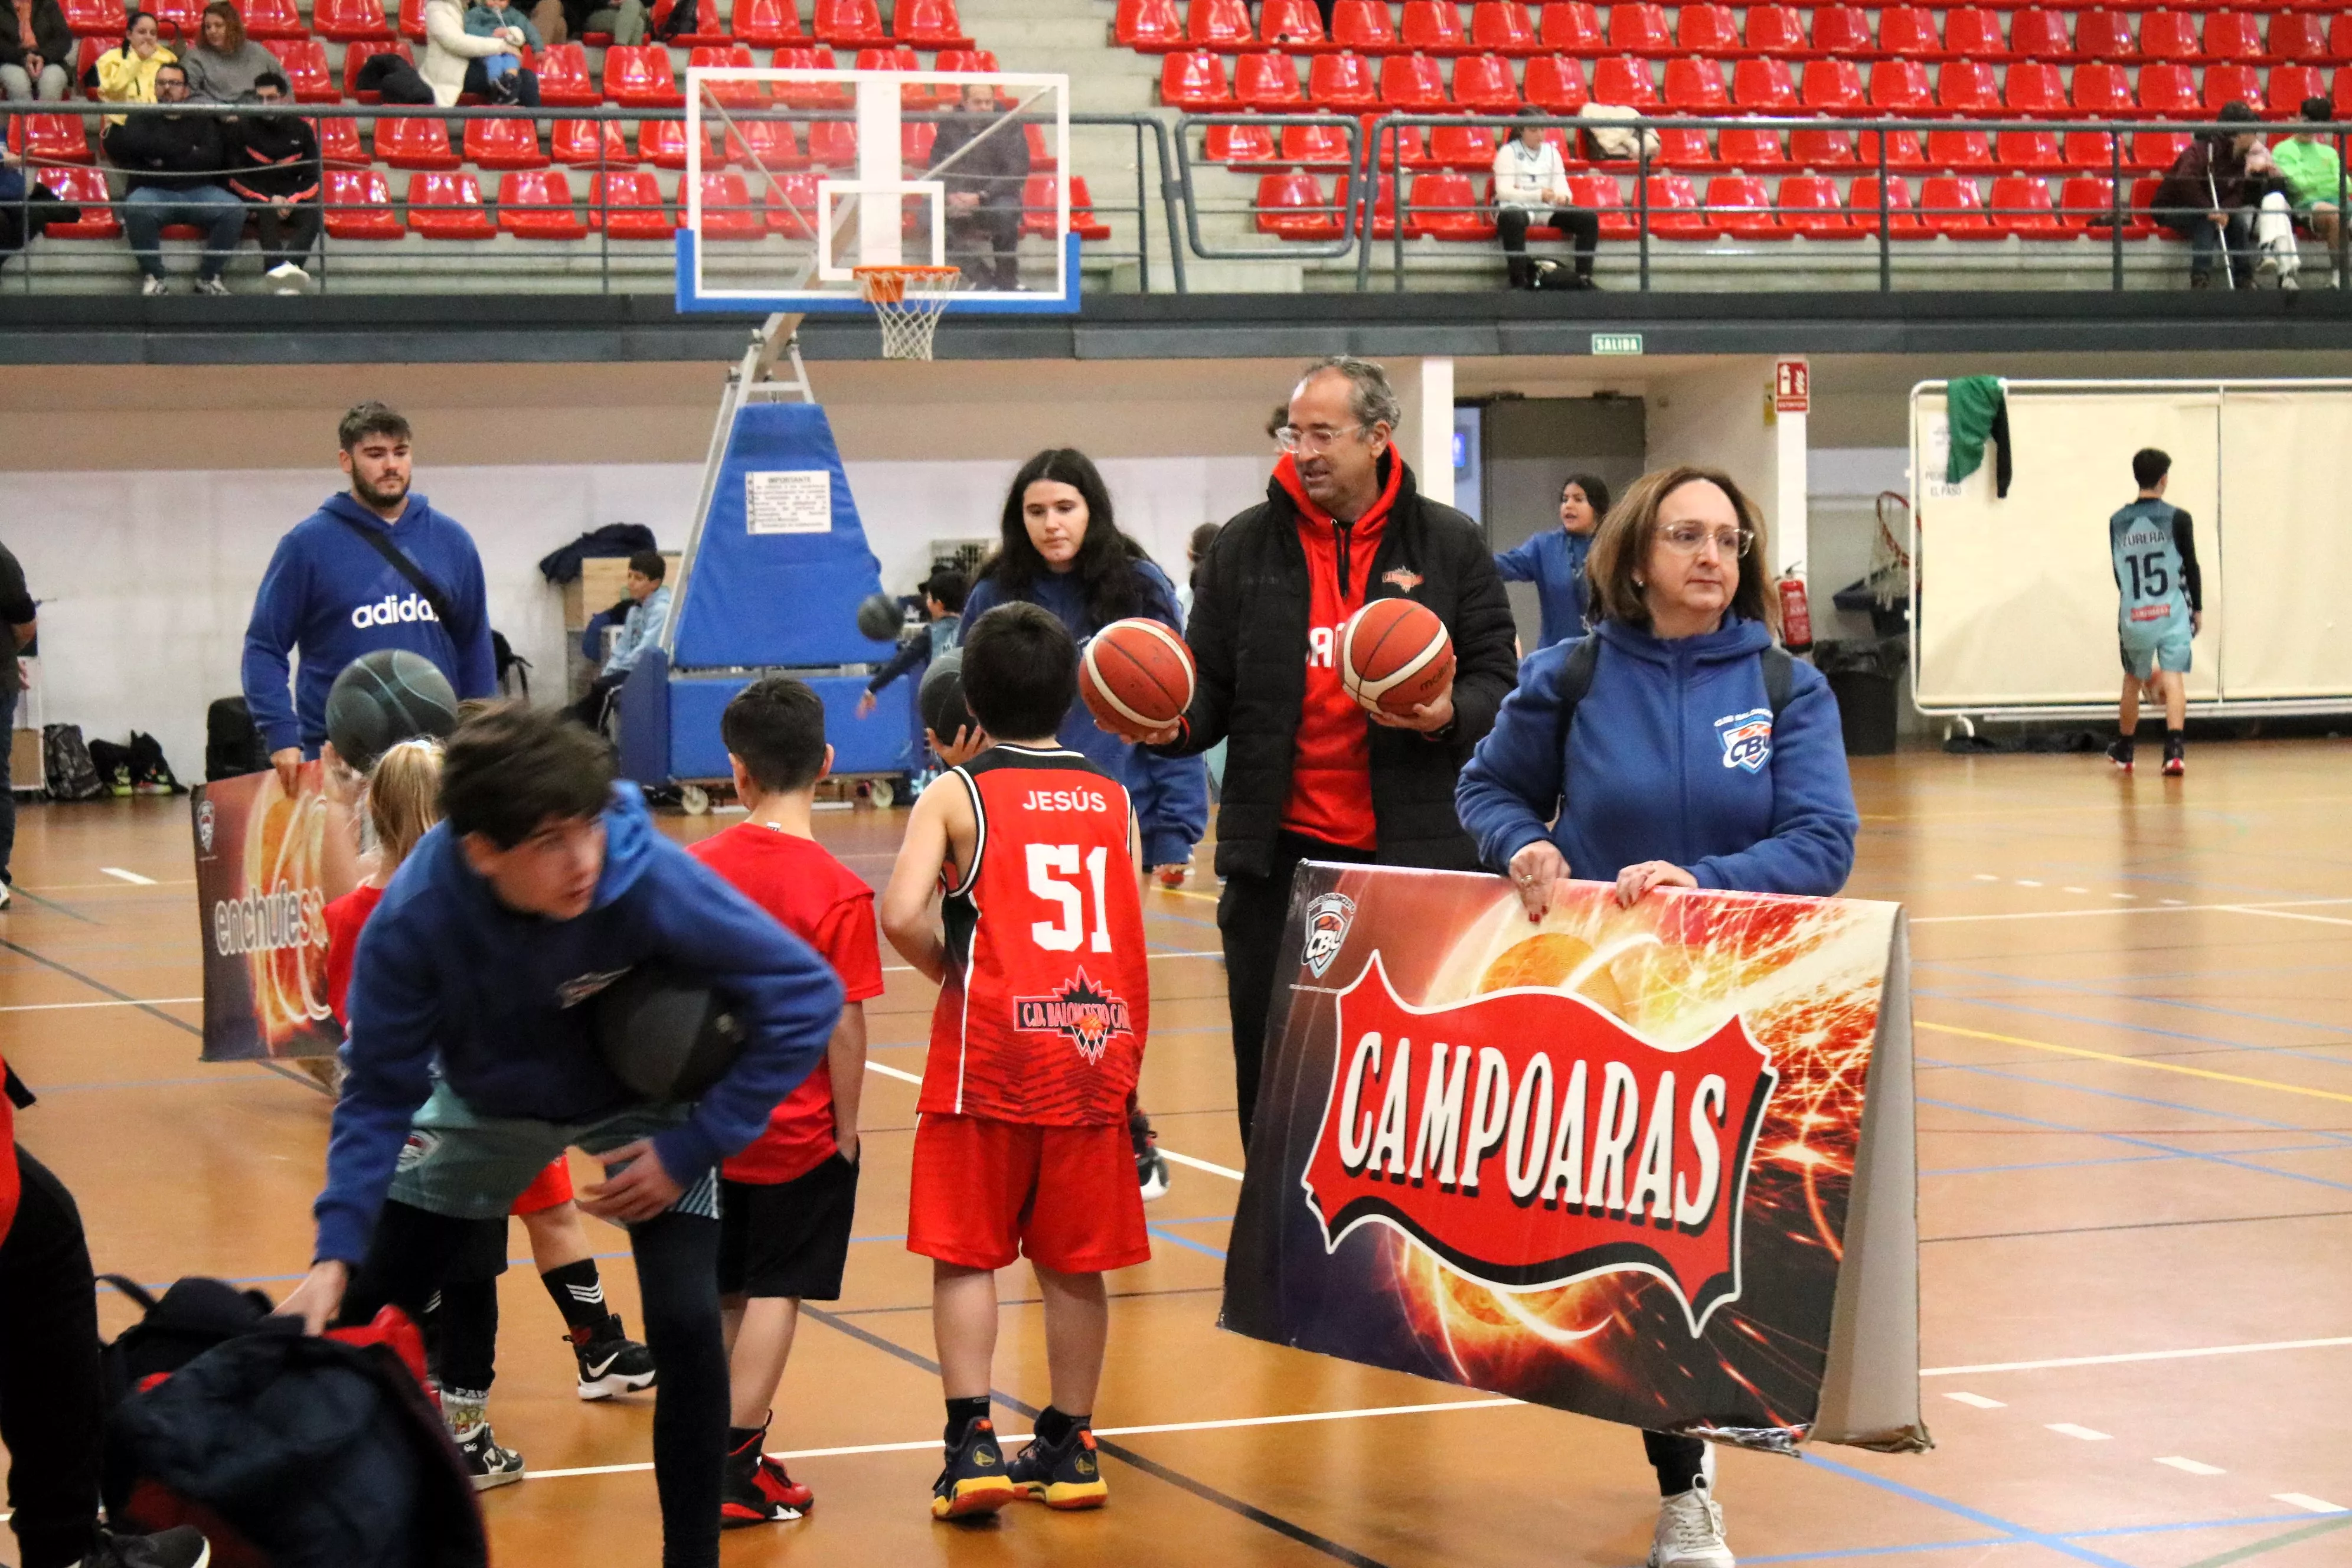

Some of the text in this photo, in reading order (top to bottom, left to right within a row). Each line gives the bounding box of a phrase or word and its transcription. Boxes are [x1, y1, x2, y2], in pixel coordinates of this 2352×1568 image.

[1596, 338, 1638, 351] SALIDA
[2125, 551, 2168, 600] 15
[351, 593, 440, 629] adida
[1023, 786, 1107, 812] JESÚS
[1024, 842, 1113, 953] 51
[1338, 1031, 1727, 1228] CAMPOARAS
